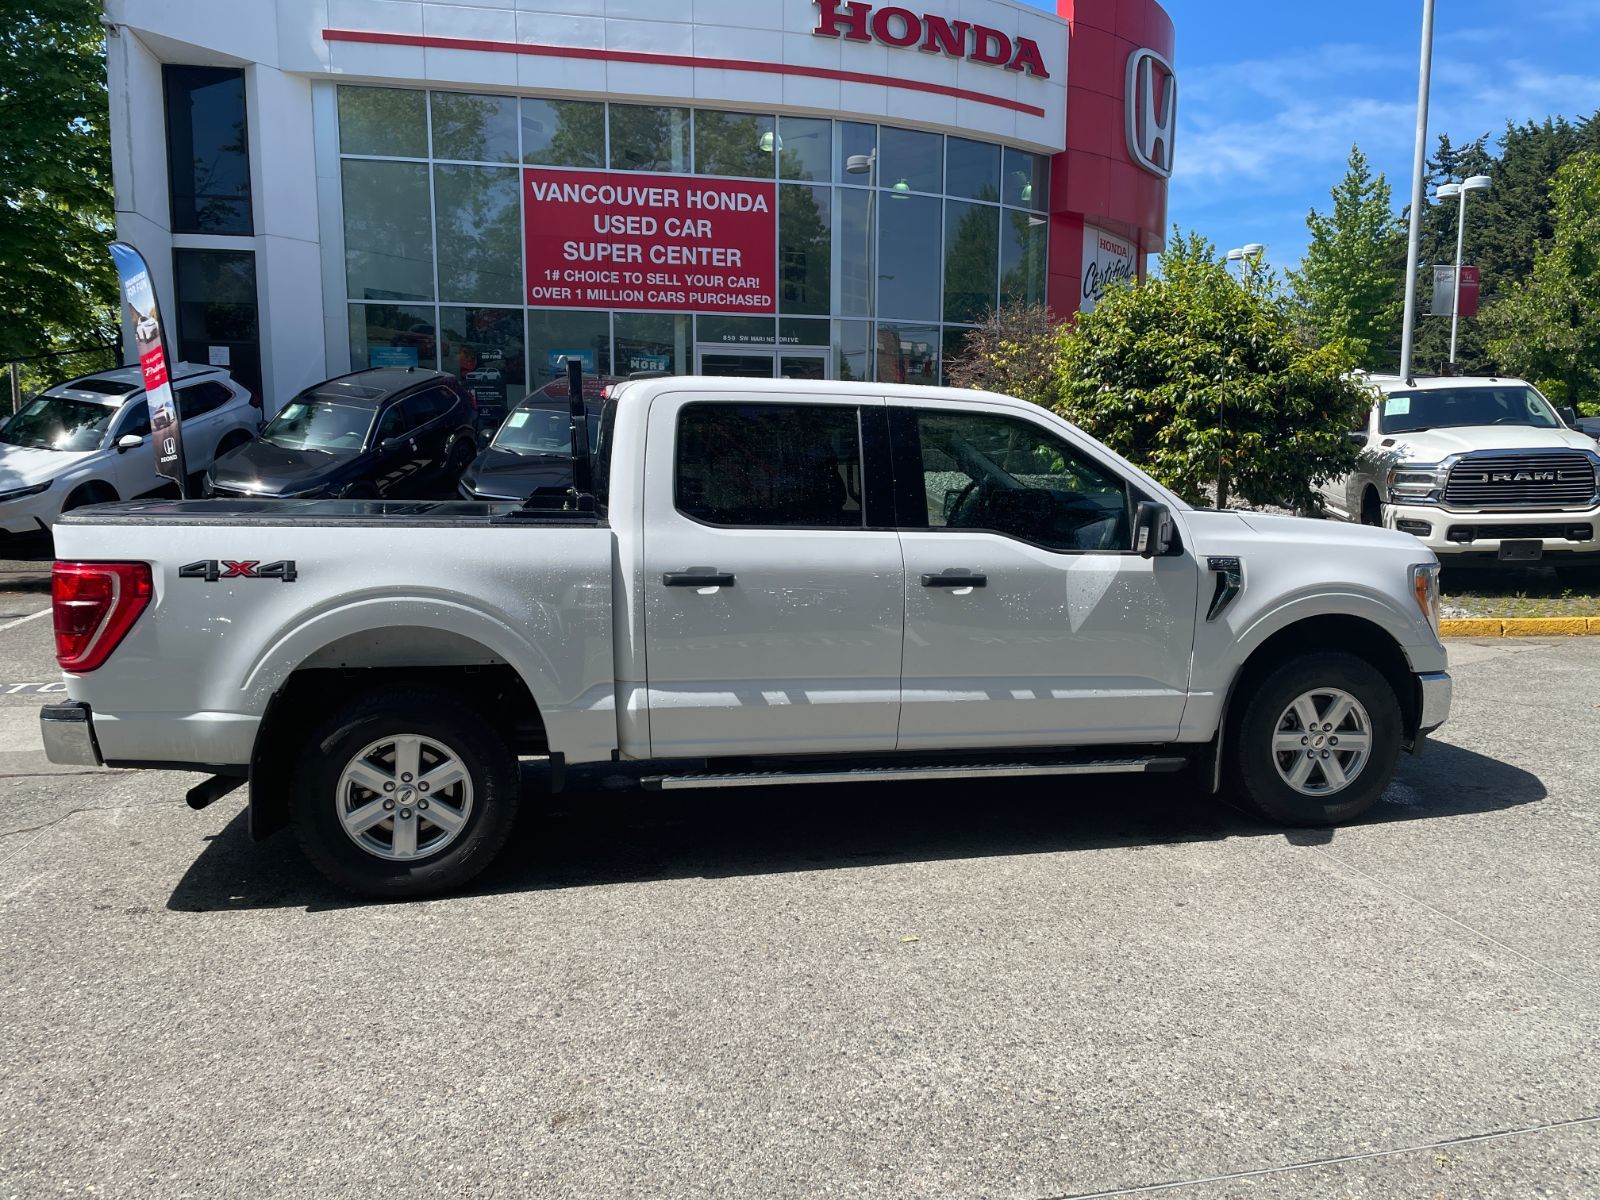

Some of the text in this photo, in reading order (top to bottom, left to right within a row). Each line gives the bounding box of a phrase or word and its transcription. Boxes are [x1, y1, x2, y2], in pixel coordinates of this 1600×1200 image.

[813, 0, 1050, 79] HONDA
[531, 181, 769, 213] VANCOUVER HONDA
[593, 214, 712, 238] USED CAR
[563, 241, 742, 267] SUPER CENTER
[1099, 238, 1128, 258] HONDA
[544, 269, 760, 289] 1# CHOICE TO SELL YOUR CAR!
[532, 286, 771, 307] OVER 1 MILLION CARS PURCHASED
[160, 454, 178, 463] HOND
[1492, 471, 1554, 481] RAM
